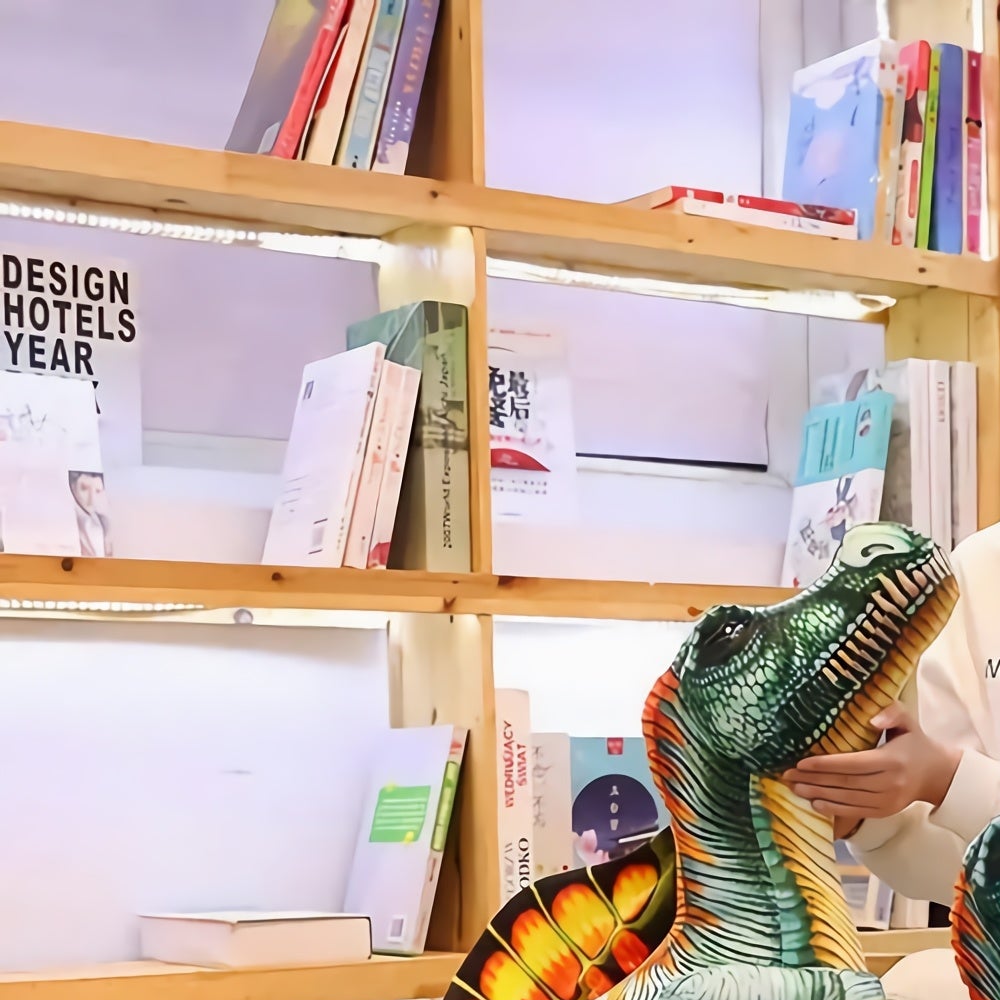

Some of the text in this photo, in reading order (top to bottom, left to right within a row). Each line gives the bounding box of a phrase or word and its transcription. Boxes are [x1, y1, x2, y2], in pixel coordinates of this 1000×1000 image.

[3, 254, 129, 305] DESIGN
[4, 293, 136, 343] HOTELS
[4, 331, 94, 376] YEAR
[518, 837, 531, 889] ODKO
